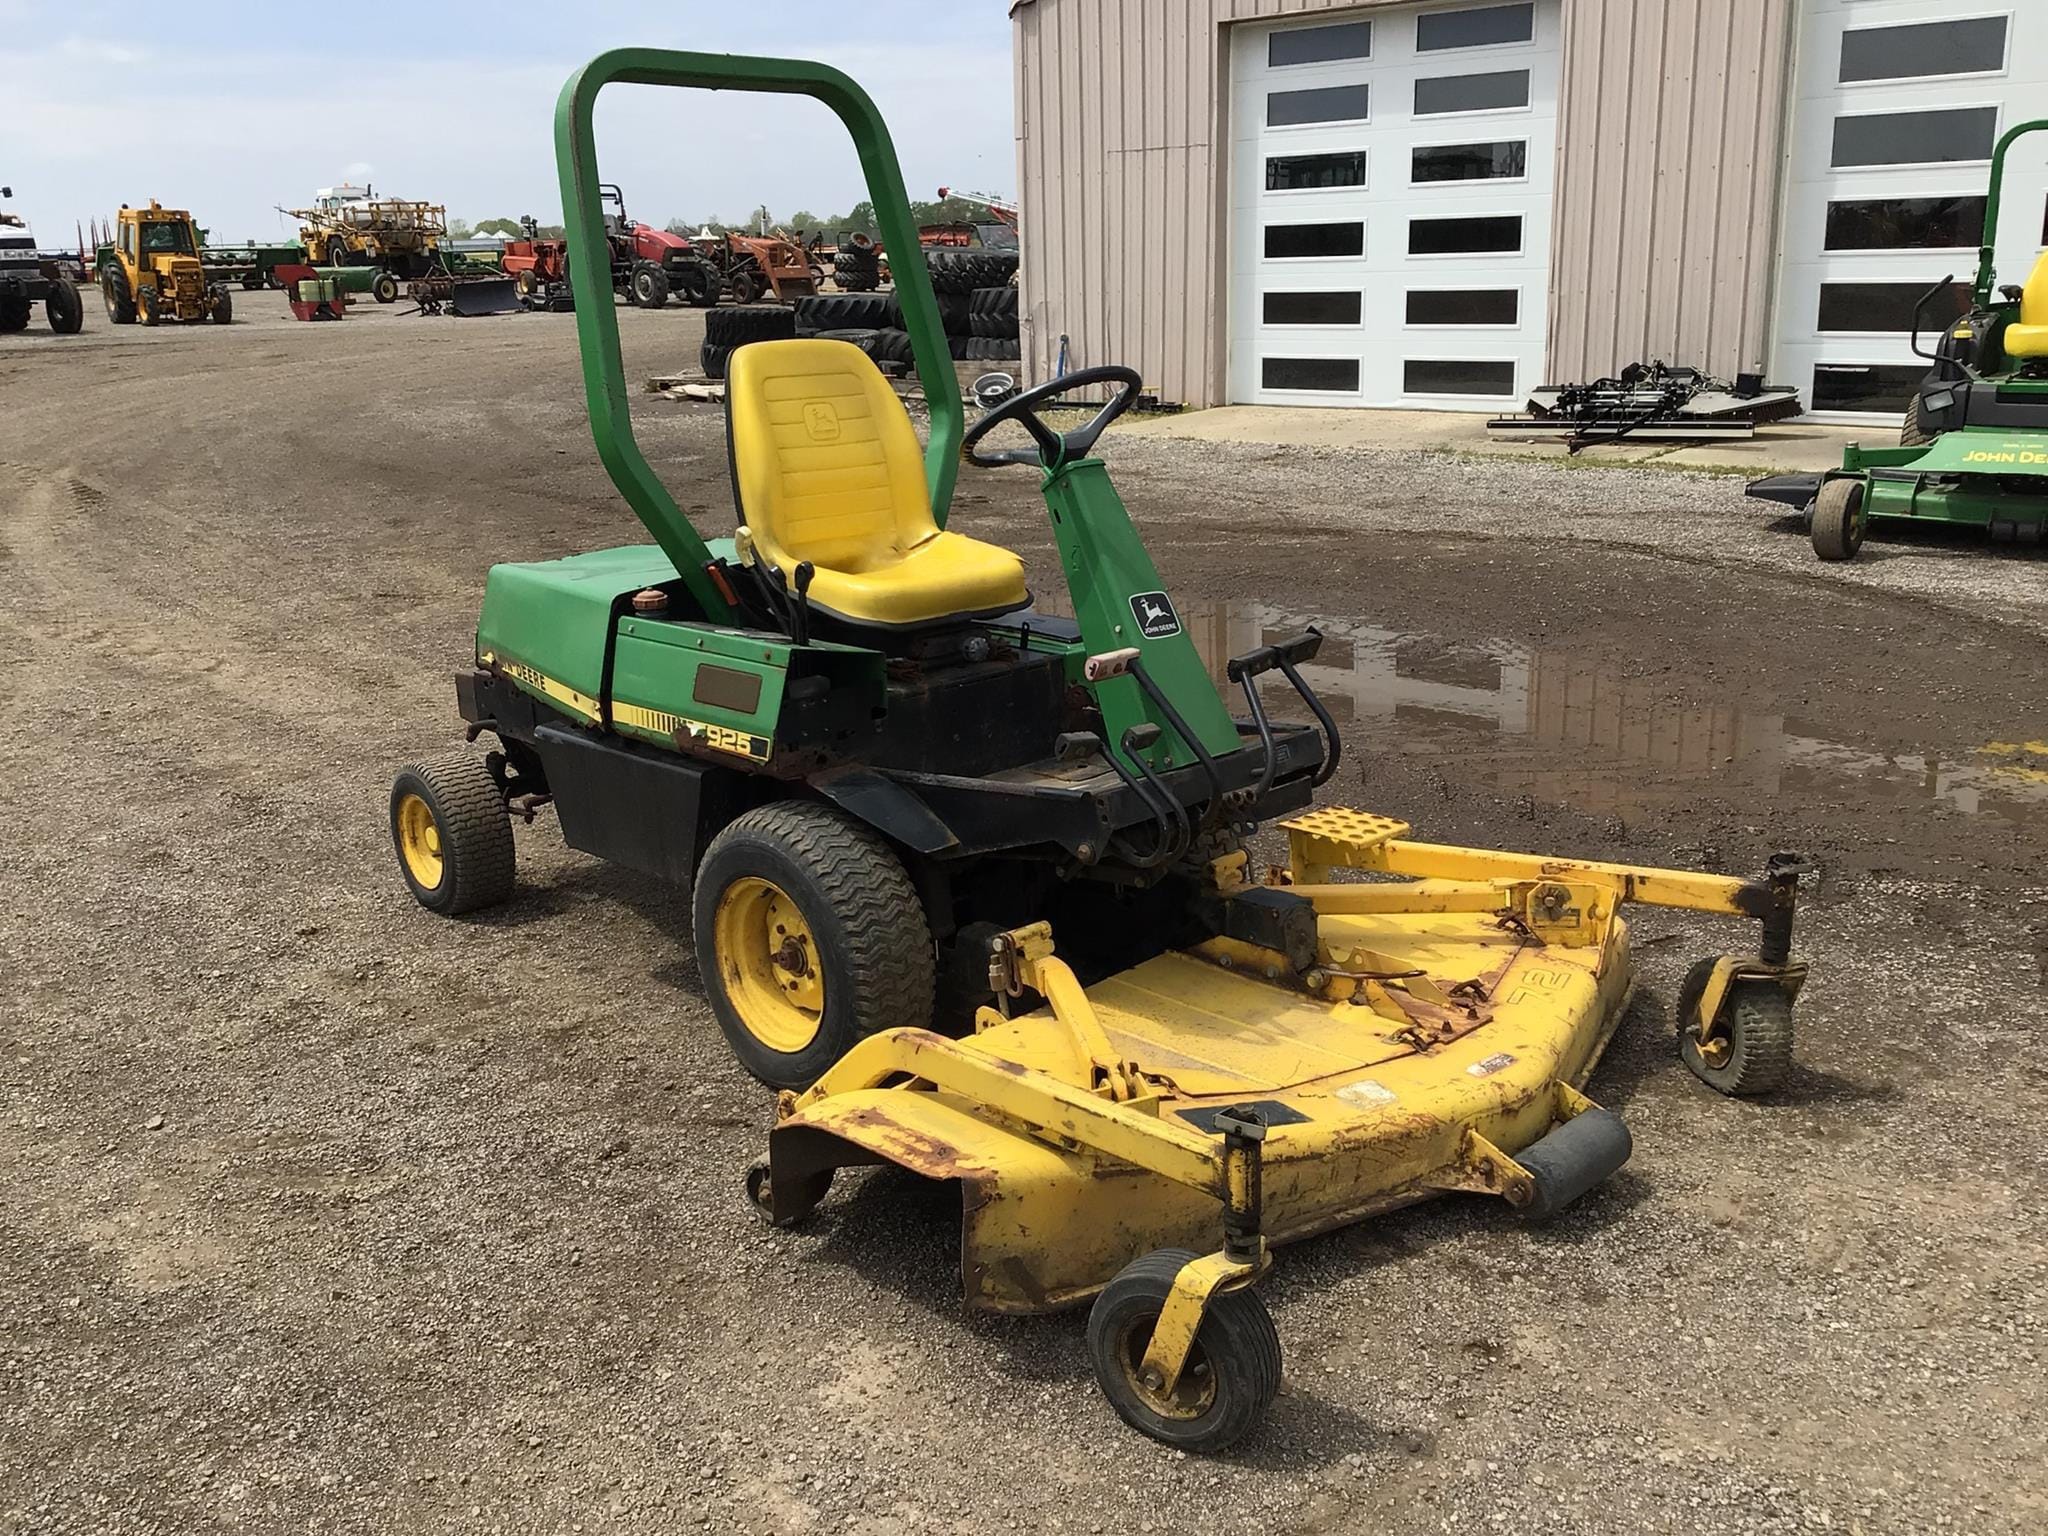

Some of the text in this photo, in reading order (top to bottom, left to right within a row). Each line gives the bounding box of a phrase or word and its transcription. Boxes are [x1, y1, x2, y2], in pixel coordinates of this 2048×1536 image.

[1962, 450, 2048, 464] JOHN DE
[1145, 622, 1177, 634] JOHN DEERE
[516, 662, 546, 691] DEERE
